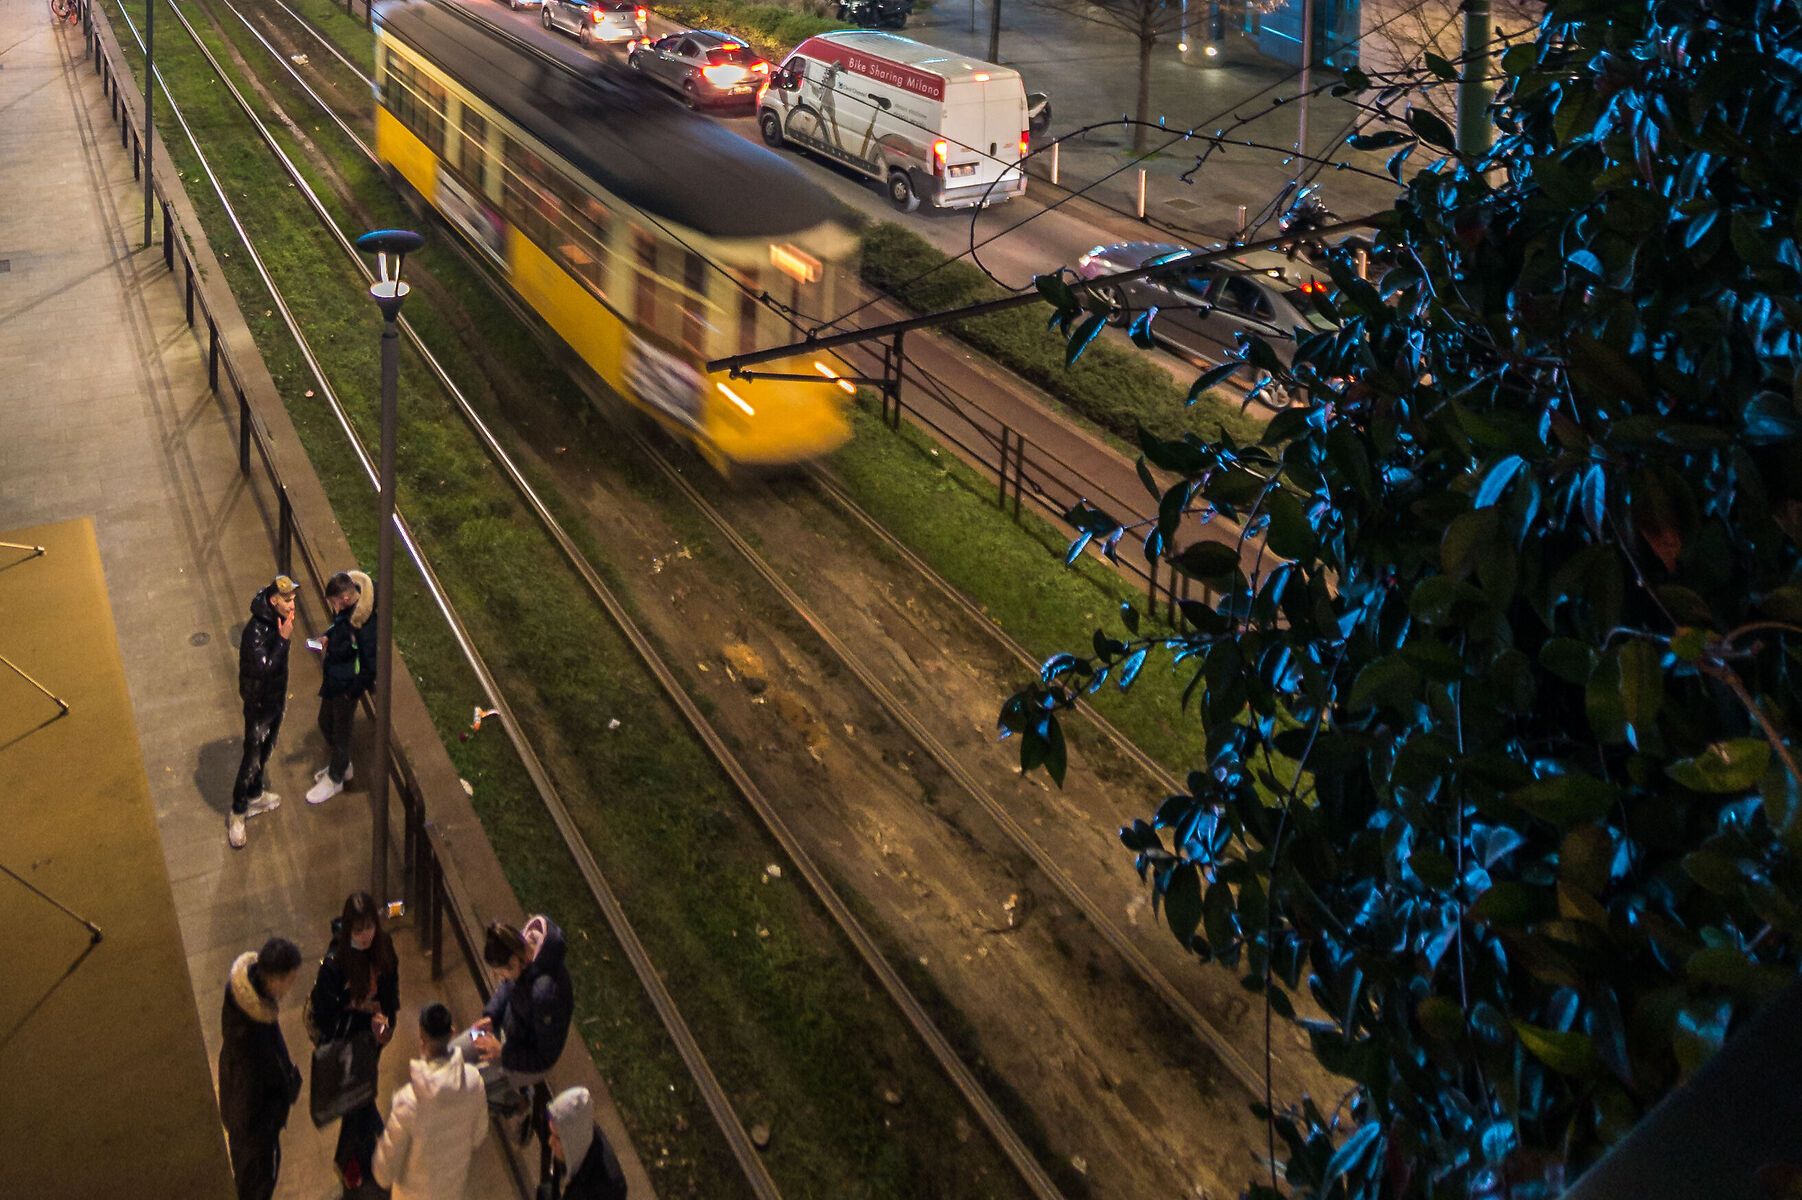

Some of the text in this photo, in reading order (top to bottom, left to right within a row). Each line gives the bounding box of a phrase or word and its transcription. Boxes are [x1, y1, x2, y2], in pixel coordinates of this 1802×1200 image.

[848, 57, 940, 96] Bike Sharing Milano
